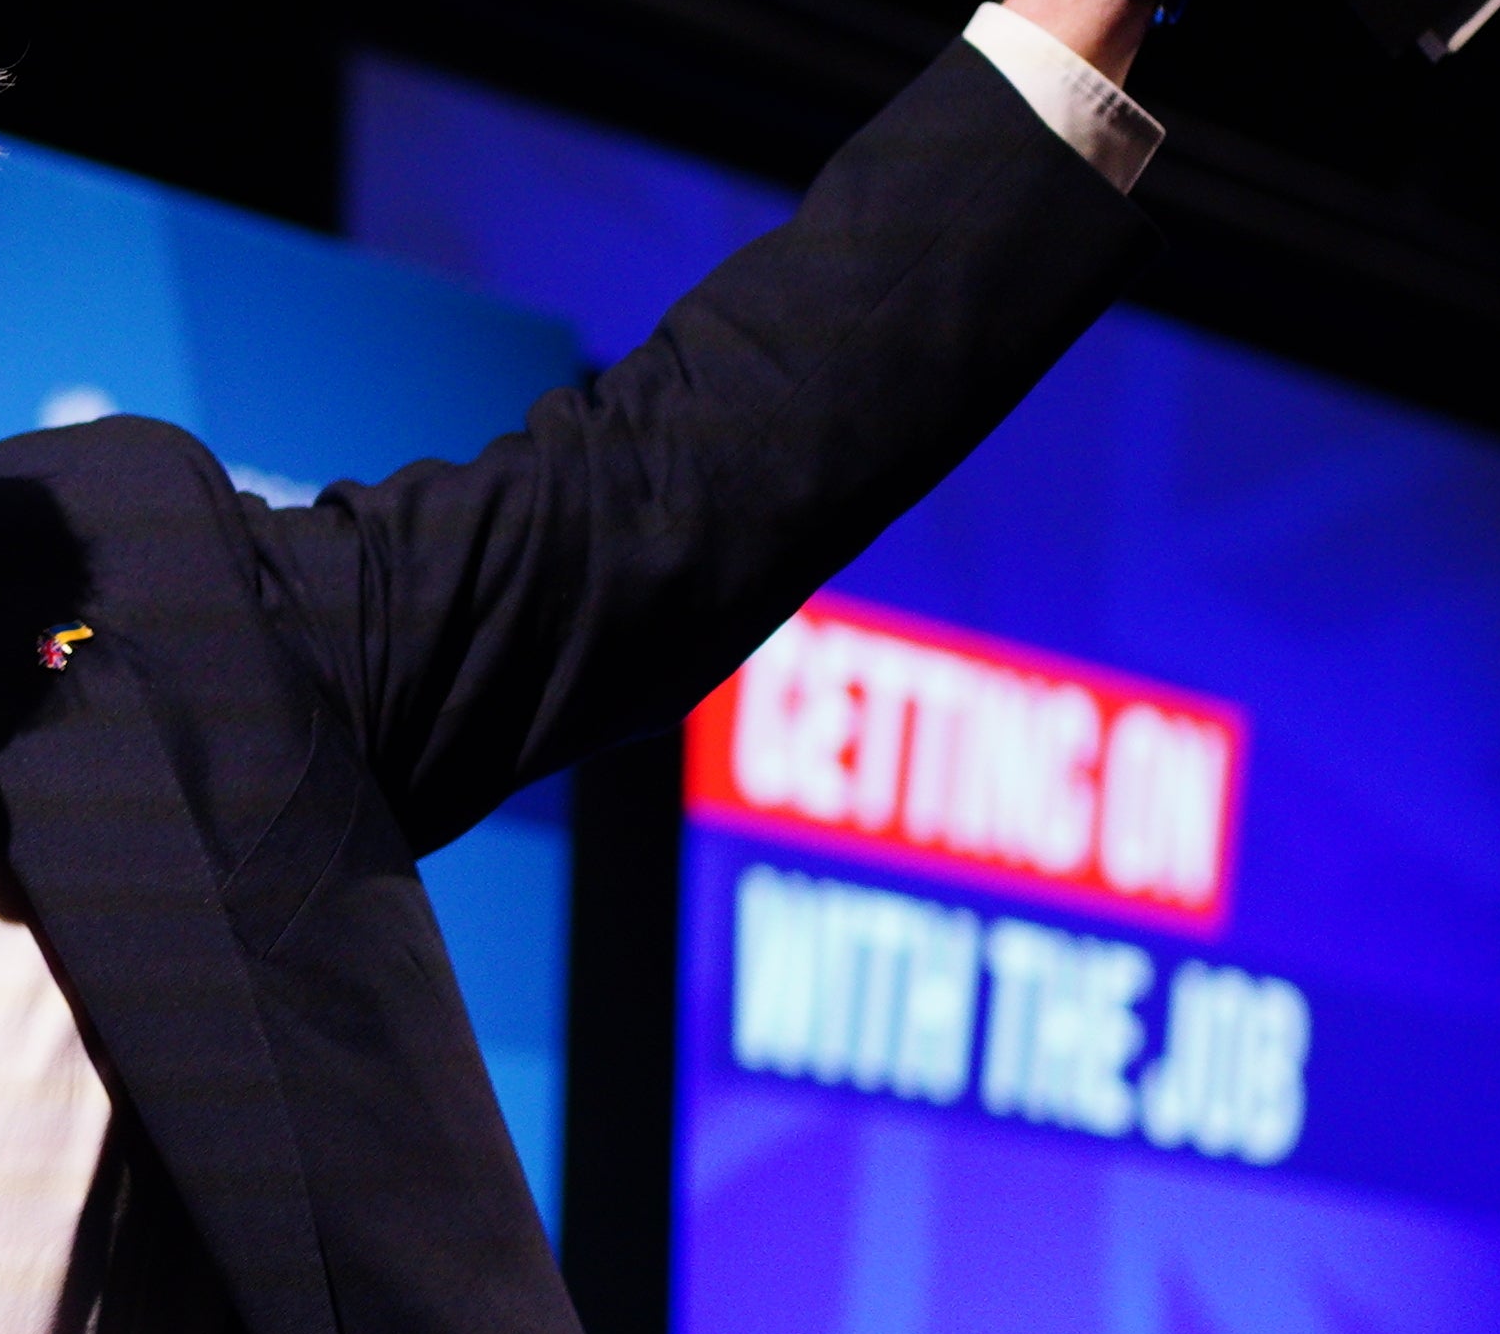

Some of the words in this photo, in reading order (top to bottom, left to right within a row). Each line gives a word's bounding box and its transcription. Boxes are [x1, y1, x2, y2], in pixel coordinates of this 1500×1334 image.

[732, 610, 1102, 874] GETTING
[1103, 700, 1230, 910] ON
[732, 863, 983, 1105] WITH
[981, 915, 1154, 1138] THE
[1137, 959, 1311, 1165] JOB
